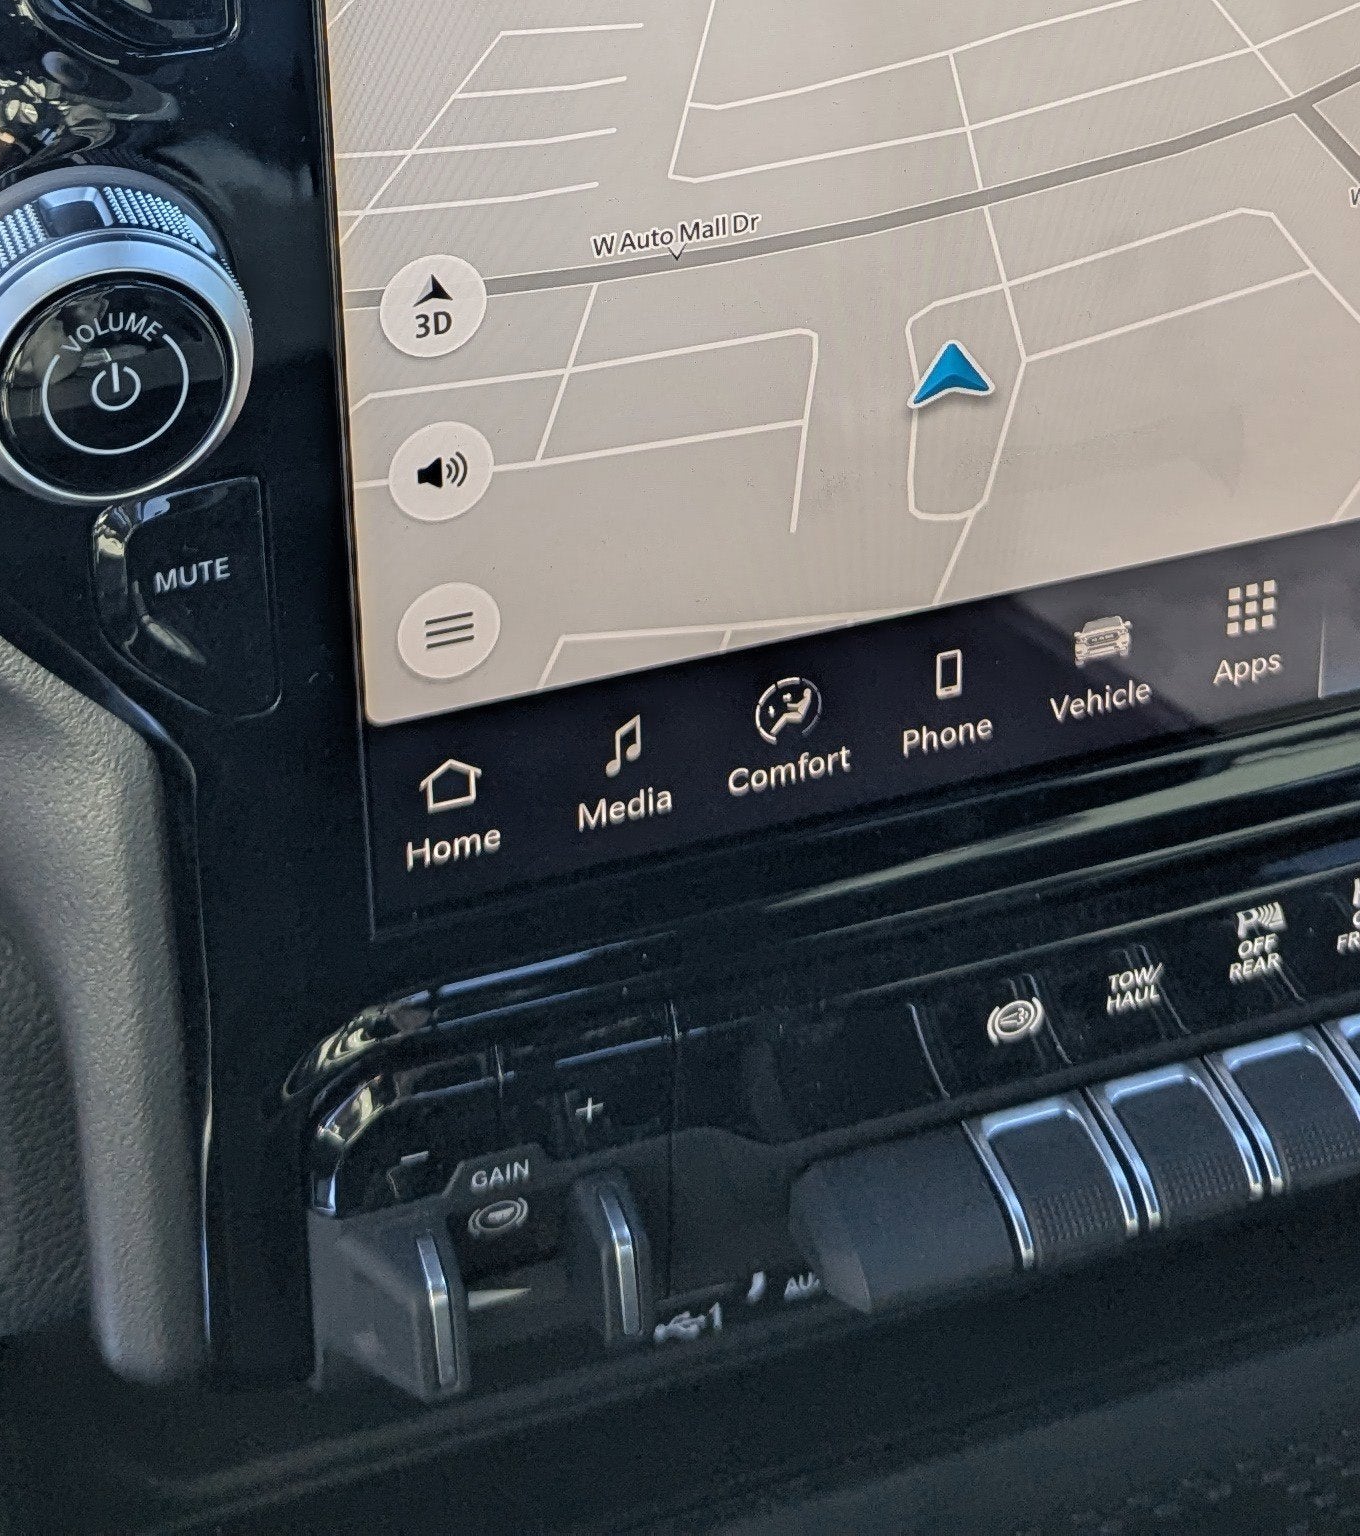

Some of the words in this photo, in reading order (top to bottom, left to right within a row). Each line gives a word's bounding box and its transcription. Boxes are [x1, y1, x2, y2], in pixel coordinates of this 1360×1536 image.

[592, 234, 617, 258] W
[620, 229, 674, 252] Auto
[680, 217, 728, 244] Mall
[733, 214, 760, 234] Dr
[61, 311, 163, 353] VOLUME
[415, 310, 453, 339] 3D
[153, 556, 231, 594] MUTE
[1212, 653, 1282, 687] Apps
[1050, 679, 1152, 723] Vehicle
[902, 716, 993, 758] Phone
[727, 745, 851, 797] Comfort
[577, 784, 673, 833] Media
[406, 826, 502, 872] Home
[1238, 933, 1279, 960] OFF
[1108, 963, 1163, 991] TOW/
[1229, 952, 1282, 984] REAR
[1106, 982, 1160, 1015] HAUL
[470, 1158, 530, 1192] GAIN
